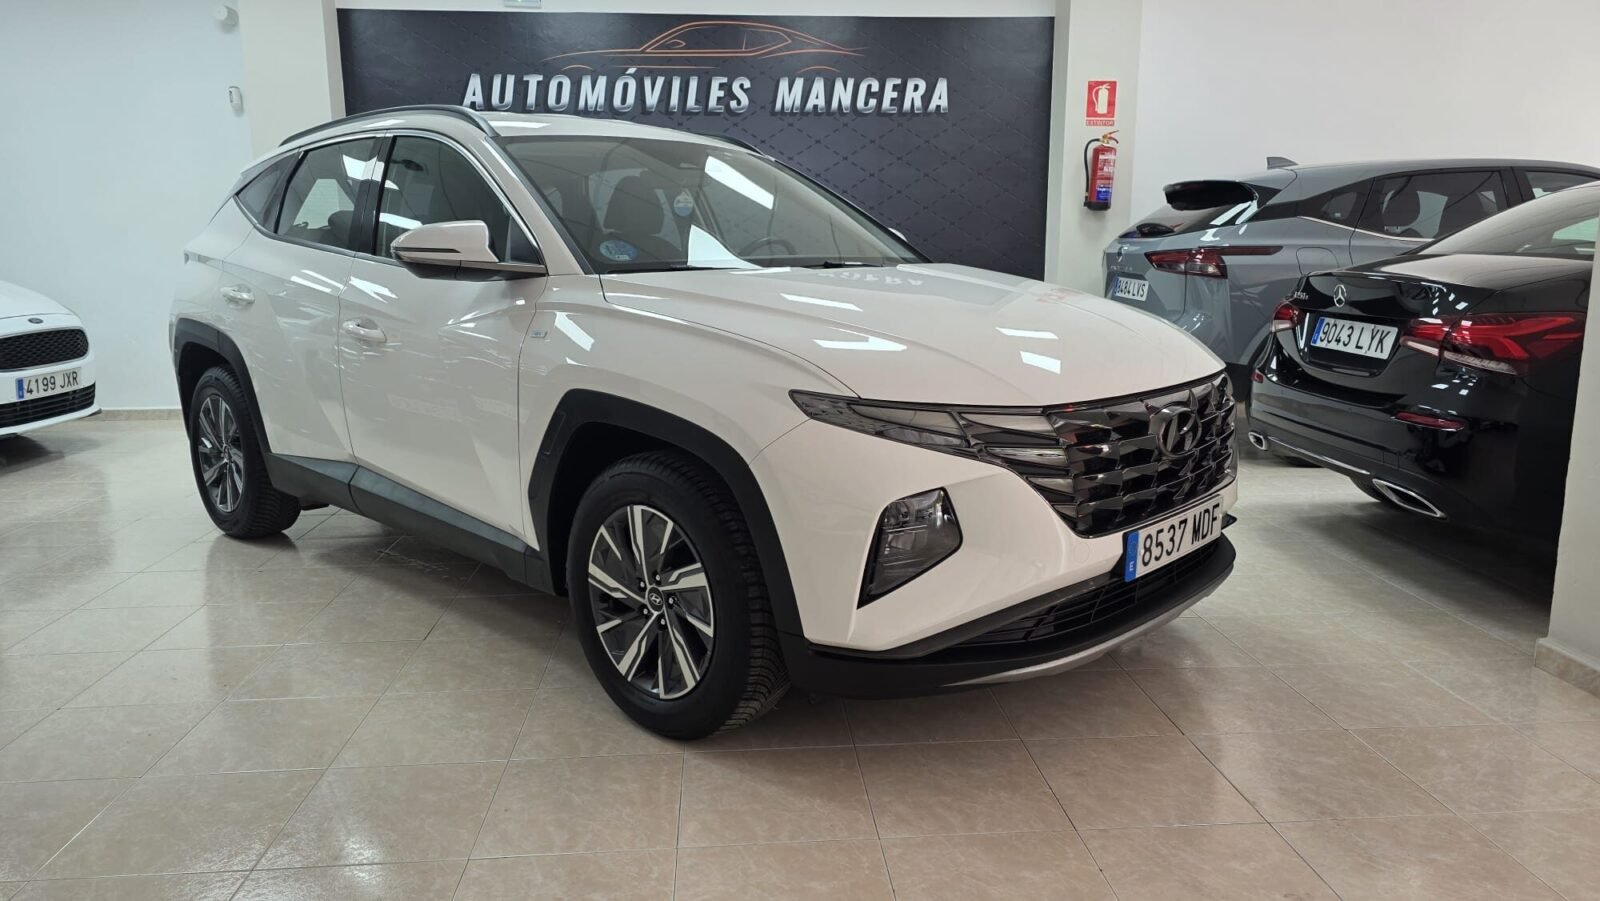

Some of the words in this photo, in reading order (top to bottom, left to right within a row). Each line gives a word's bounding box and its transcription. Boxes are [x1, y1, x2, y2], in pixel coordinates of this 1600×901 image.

[462, 68, 751, 112] AUTOMÓVILES
[775, 76, 949, 114] MANCERA
[1319, 321, 1355, 347] 9043
[1355, 326, 1391, 354] LYK
[26, 376, 56, 395] 4199
[60, 370, 79, 389] JXR
[1142, 518, 1188, 567] 8537
[1191, 502, 1220, 545] MDF
